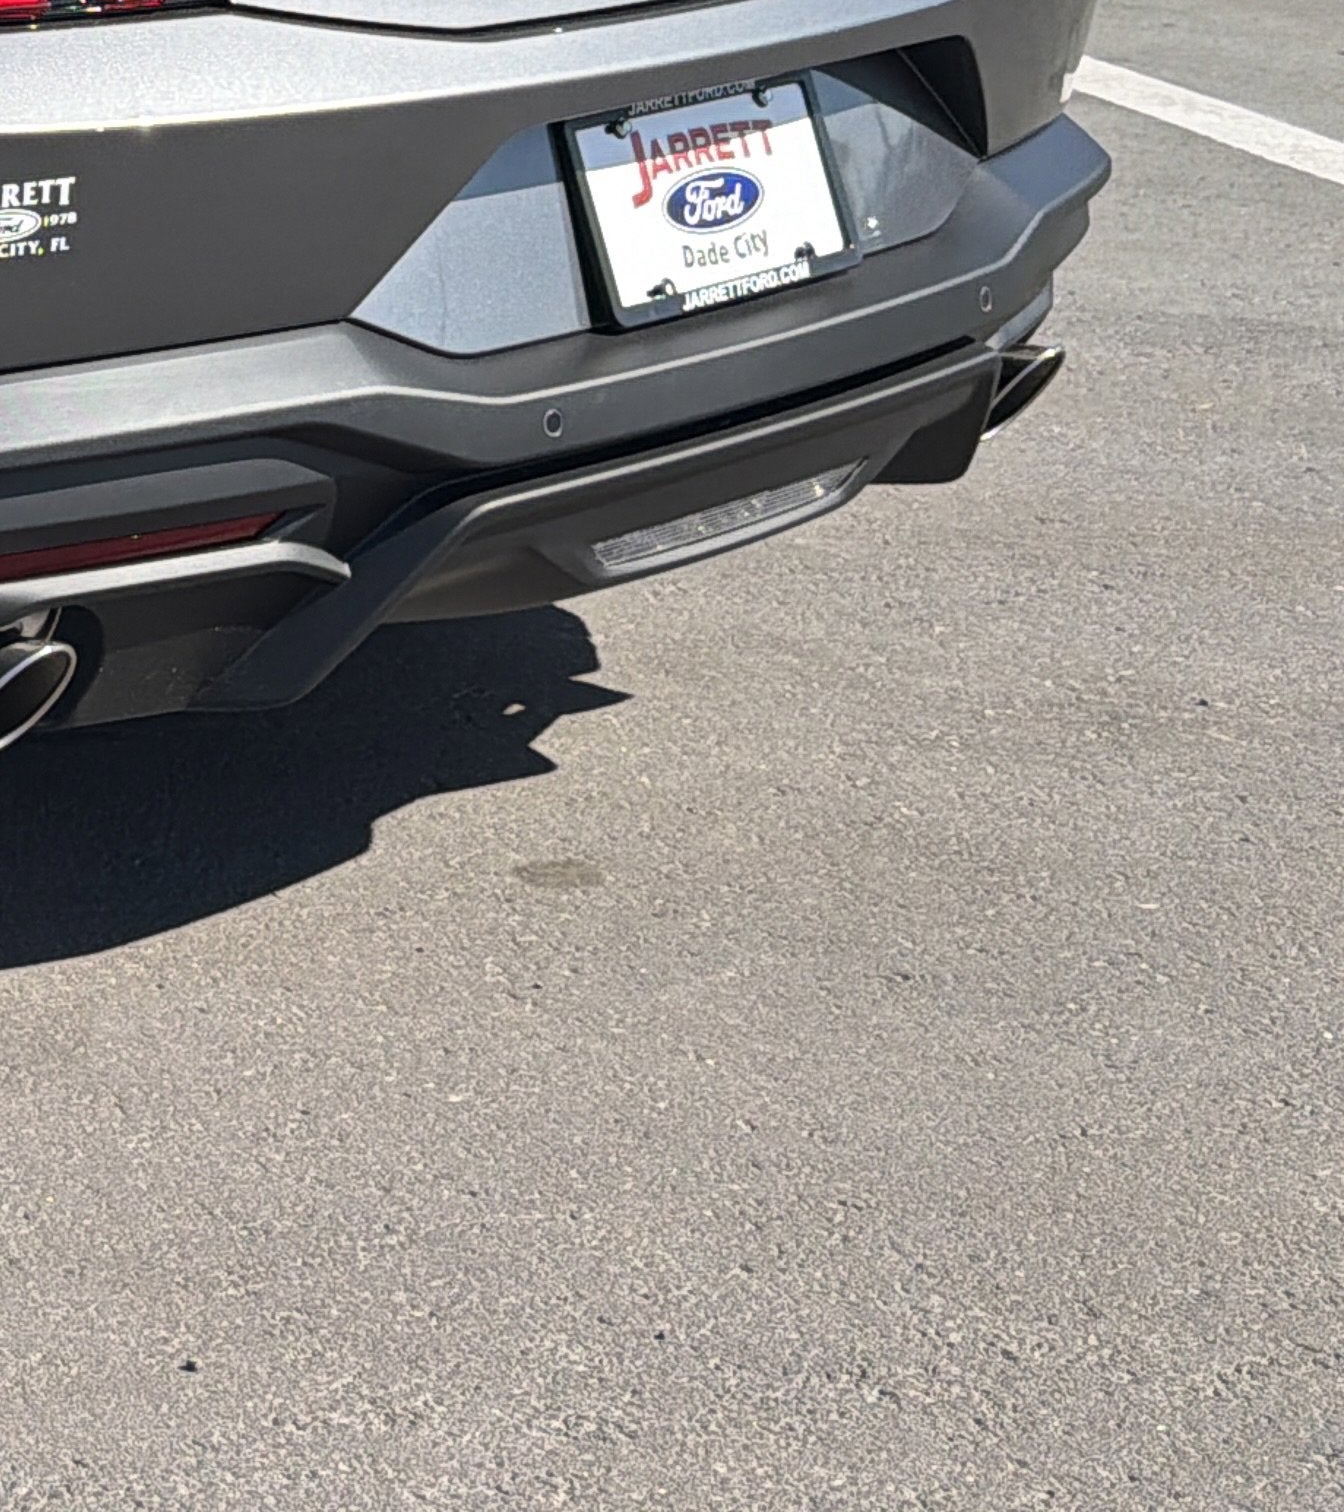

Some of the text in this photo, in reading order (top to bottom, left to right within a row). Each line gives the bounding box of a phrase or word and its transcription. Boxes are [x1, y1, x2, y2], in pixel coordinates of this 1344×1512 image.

[630, 119, 773, 208] JARRETT
[44, 212, 77, 227] 1978
[681, 176, 746, 226] Ford
[50, 237, 69, 251] FL
[682, 228, 769, 268] Dade City
[682, 257, 811, 312] JARRETTFORD.COM
